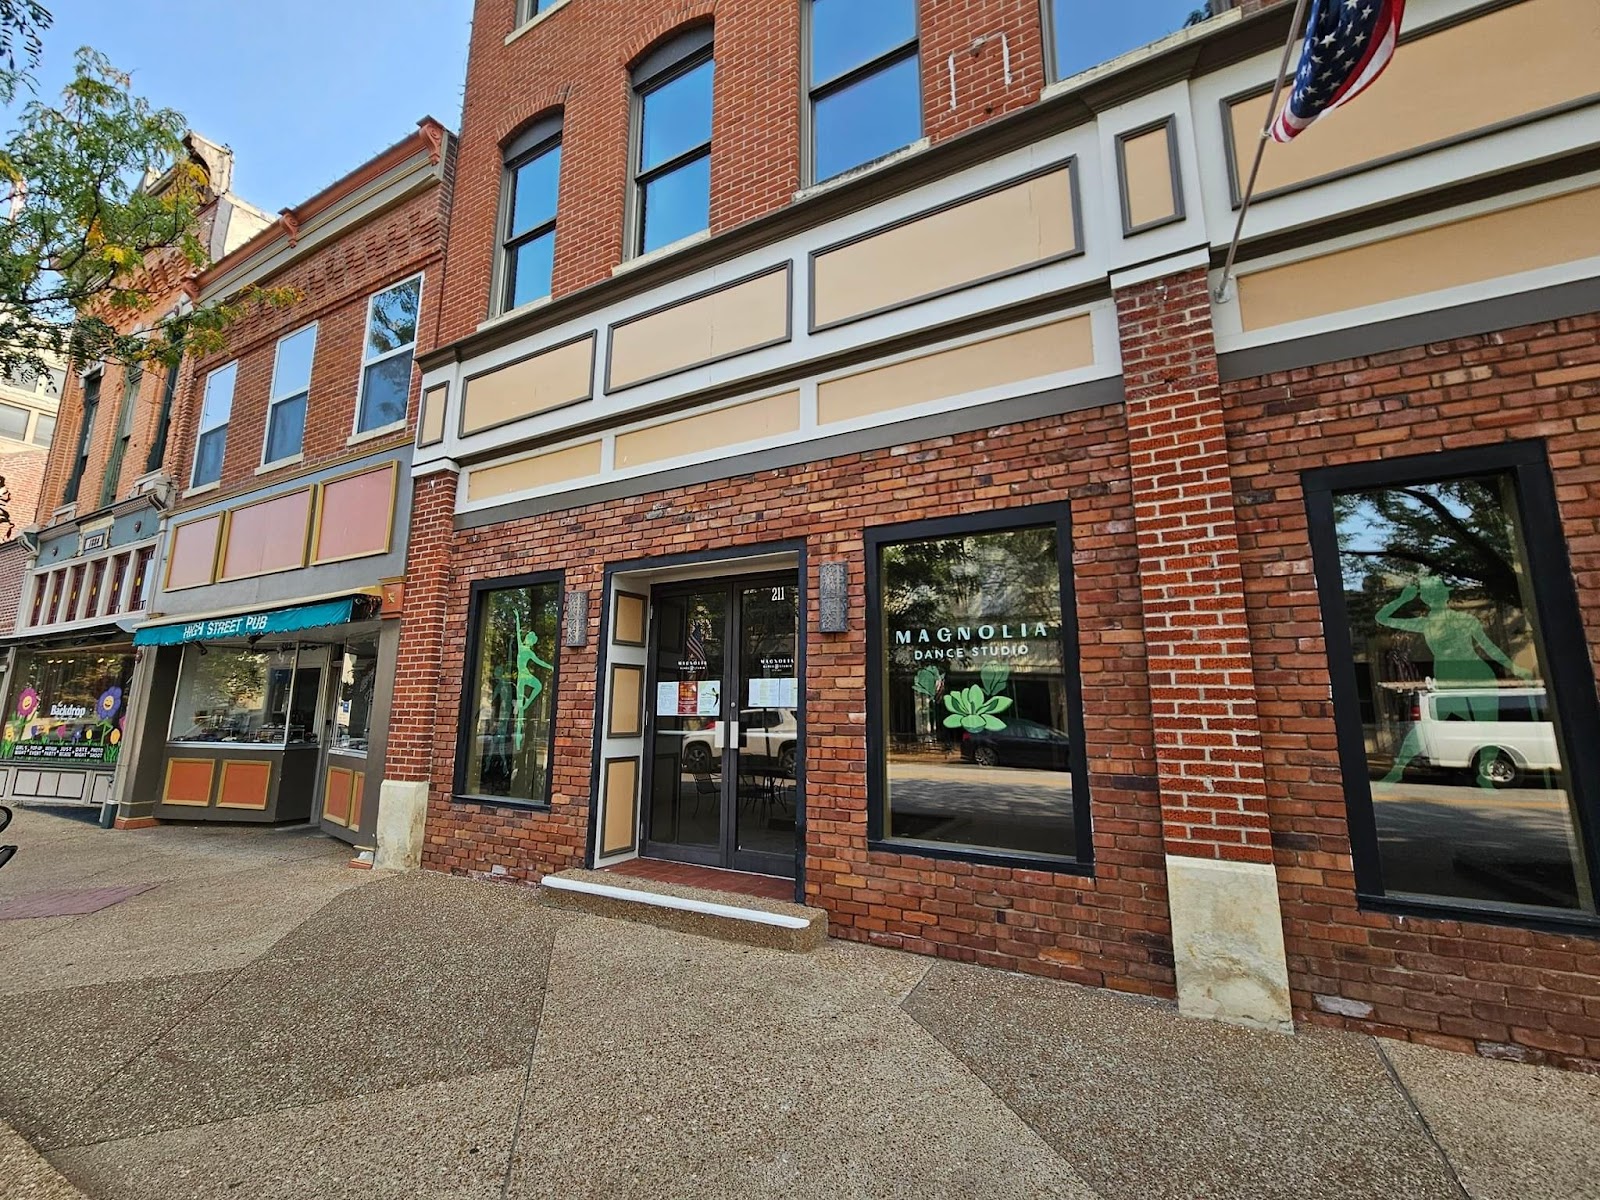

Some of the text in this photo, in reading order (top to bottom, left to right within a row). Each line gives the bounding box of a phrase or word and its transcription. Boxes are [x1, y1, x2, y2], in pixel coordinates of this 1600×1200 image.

[771, 586, 785, 601] 211
[183, 615, 268, 639] HIGH STREET PUB
[895, 622, 1047, 645] MAGNOLIA
[914, 645, 1029, 661] DANCE STUDIO
[50, 704, 86, 719] Backdrop
